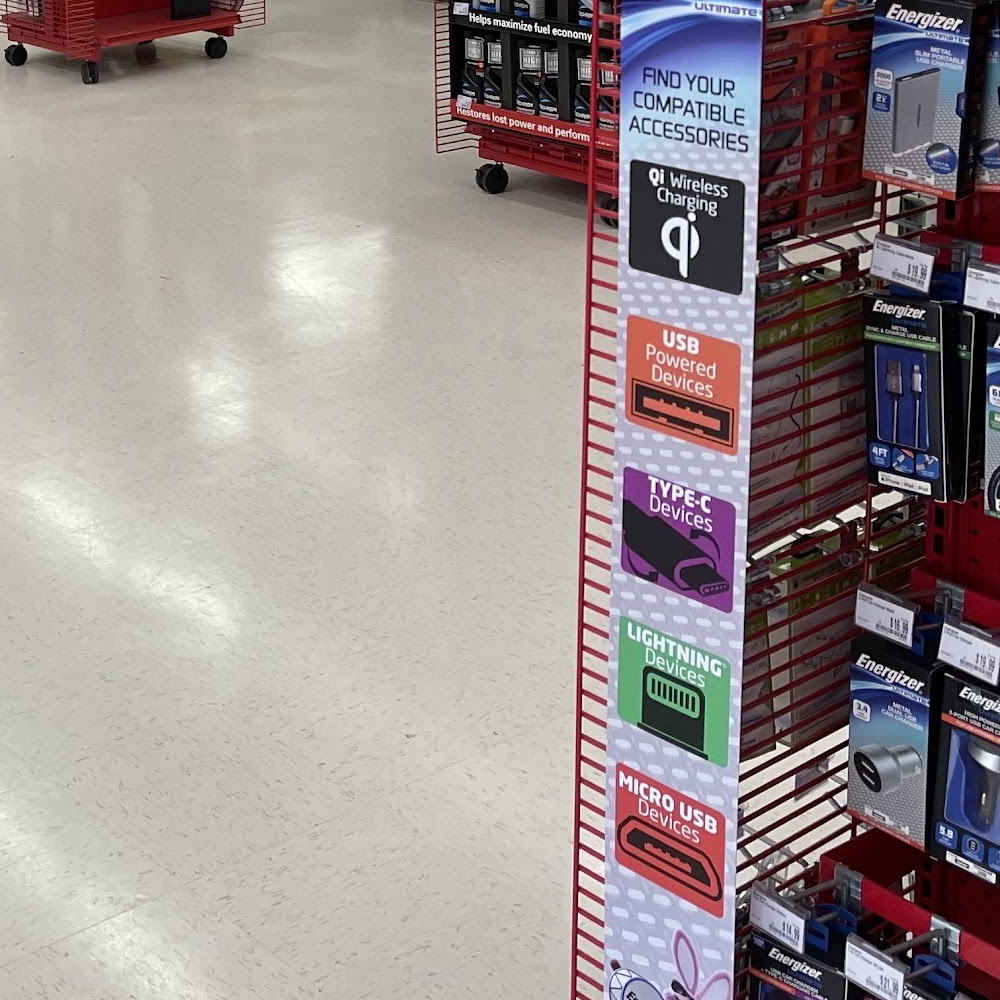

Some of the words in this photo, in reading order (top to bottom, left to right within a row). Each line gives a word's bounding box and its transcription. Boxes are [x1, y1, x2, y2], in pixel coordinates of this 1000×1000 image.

[694, 1, 758, 18] ULTIMATE
[885, 3, 963, 33] Energizer
[469, 12, 491, 26] Helps
[493, 17, 533, 33] maximize
[534, 21, 551, 35] fuel
[552, 26, 593, 43] economy
[914, 50, 930, 59] SLIM
[932, 53, 966, 65] PORTABLE
[916, 57, 929, 66] USB
[930, 59, 964, 71] CHARGER
[931, 47, 952, 57] METAL
[642, 67, 681, 90] FIND
[685, 71, 736, 99] YOUR
[456, 107, 491, 122] Restores
[492, 112, 508, 125] lost
[508, 117, 536, 132] power
[537, 124, 554, 136] and
[633, 90, 746, 127] COMPATIBLE
[628, 116, 750, 153] ACCESSORIES
[648, 167, 666, 187] Qi
[670, 172, 729, 199] Wireless
[656, 186, 718, 218] Charging
[907, 264, 928, 281] $19.99
[872, 300, 926, 321] Energizer
[662, 328, 700, 356] USB
[866, 325, 880, 333] SYNC
[885, 328, 907, 338] CHARGE
[918, 334, 937, 343] CABLE
[645, 343, 717, 381] Powered
[651, 364, 714, 399] Devices
[872, 446, 888, 459] 4FT
[648, 475, 712, 515] TYPE-C
[649, 494, 713, 533] Devices
[890, 617, 909, 636] $16.99
[627, 621, 723, 678] LIGHTNING
[975, 652, 996, 673] $19.99
[644, 647, 706, 689] Devices
[856, 653, 925, 692] Energizer
[881, 708, 893, 718] CAR
[894, 713, 924, 732] CHARGER
[888, 706, 903, 718] DUAL
[904, 713, 917, 723] USB
[893, 702, 912, 714] METAL
[964, 709, 978, 720] HIGH
[618, 769, 675, 815] MICRO
[678, 803, 718, 836] USB
[638, 799, 701, 845] Devices
[768, 947, 822, 981] Energizer
